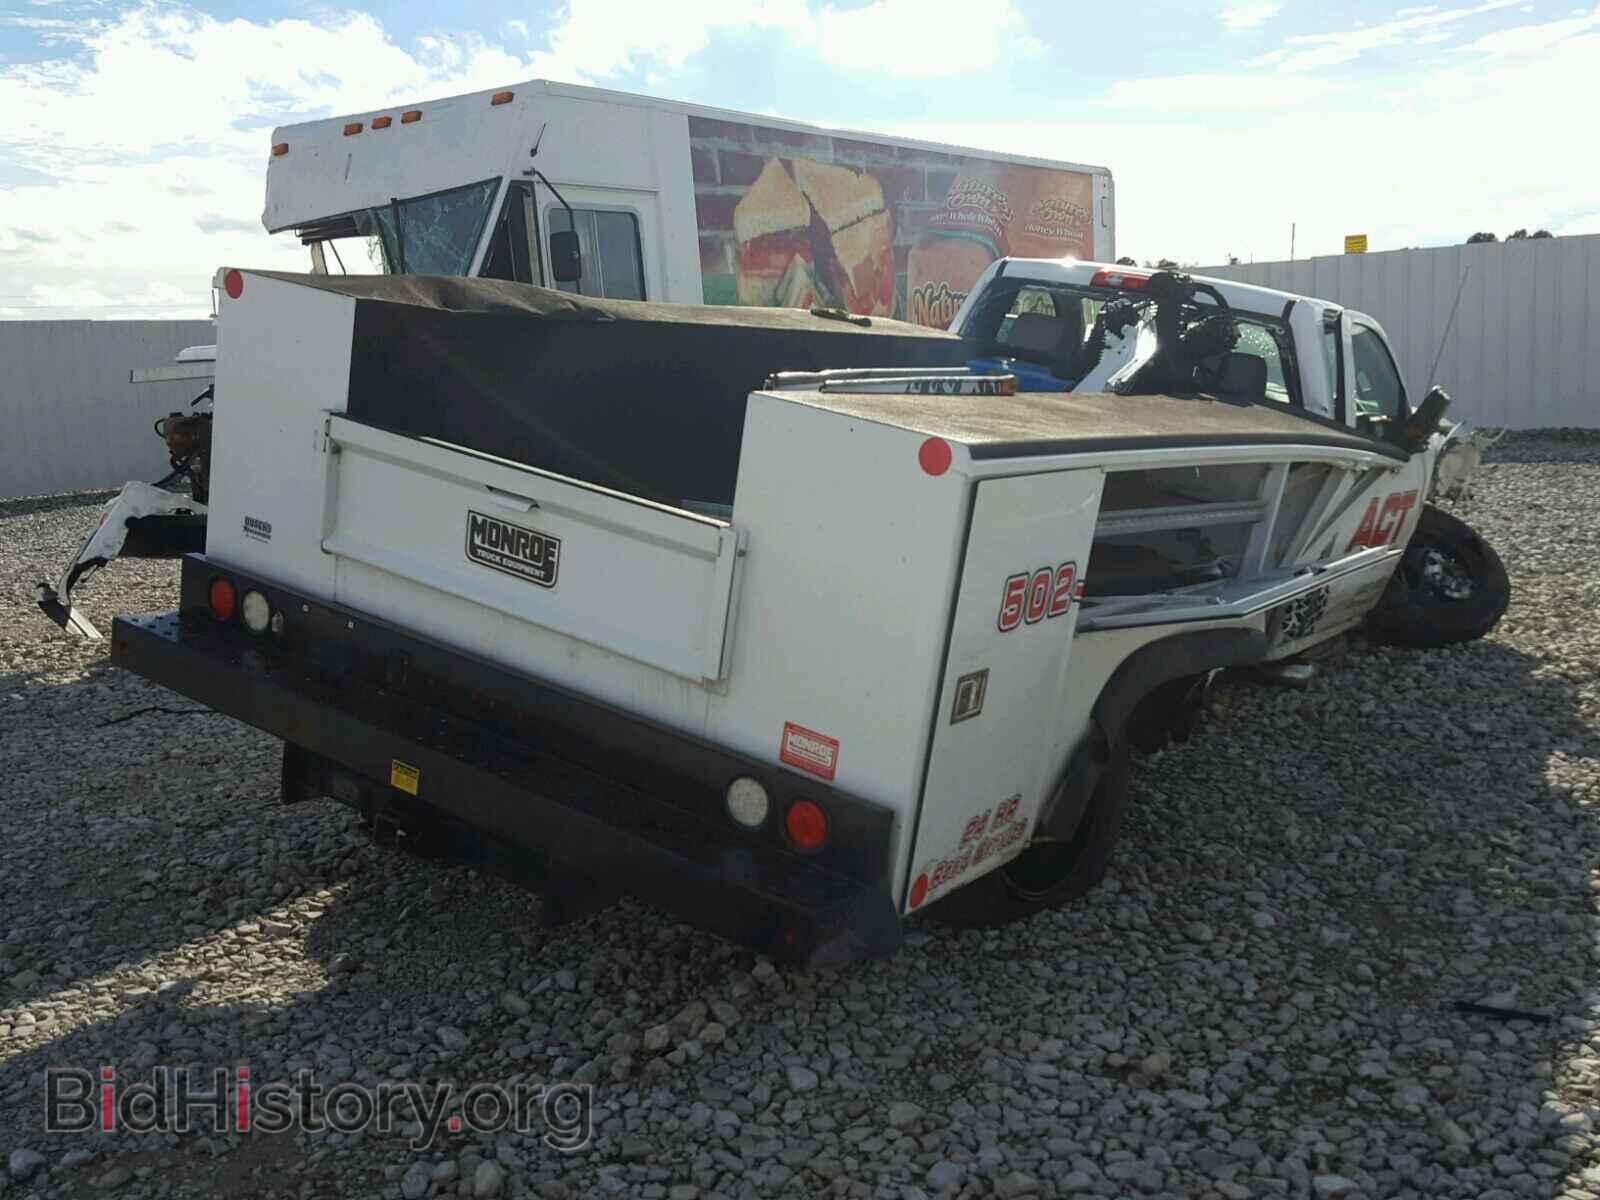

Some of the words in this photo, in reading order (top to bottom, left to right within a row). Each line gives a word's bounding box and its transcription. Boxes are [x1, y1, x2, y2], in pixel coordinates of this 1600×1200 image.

[469, 514, 558, 574] MONROE
[476, 548, 502, 563] TRUCK
[502, 556, 545, 579] EQUIPMENT
